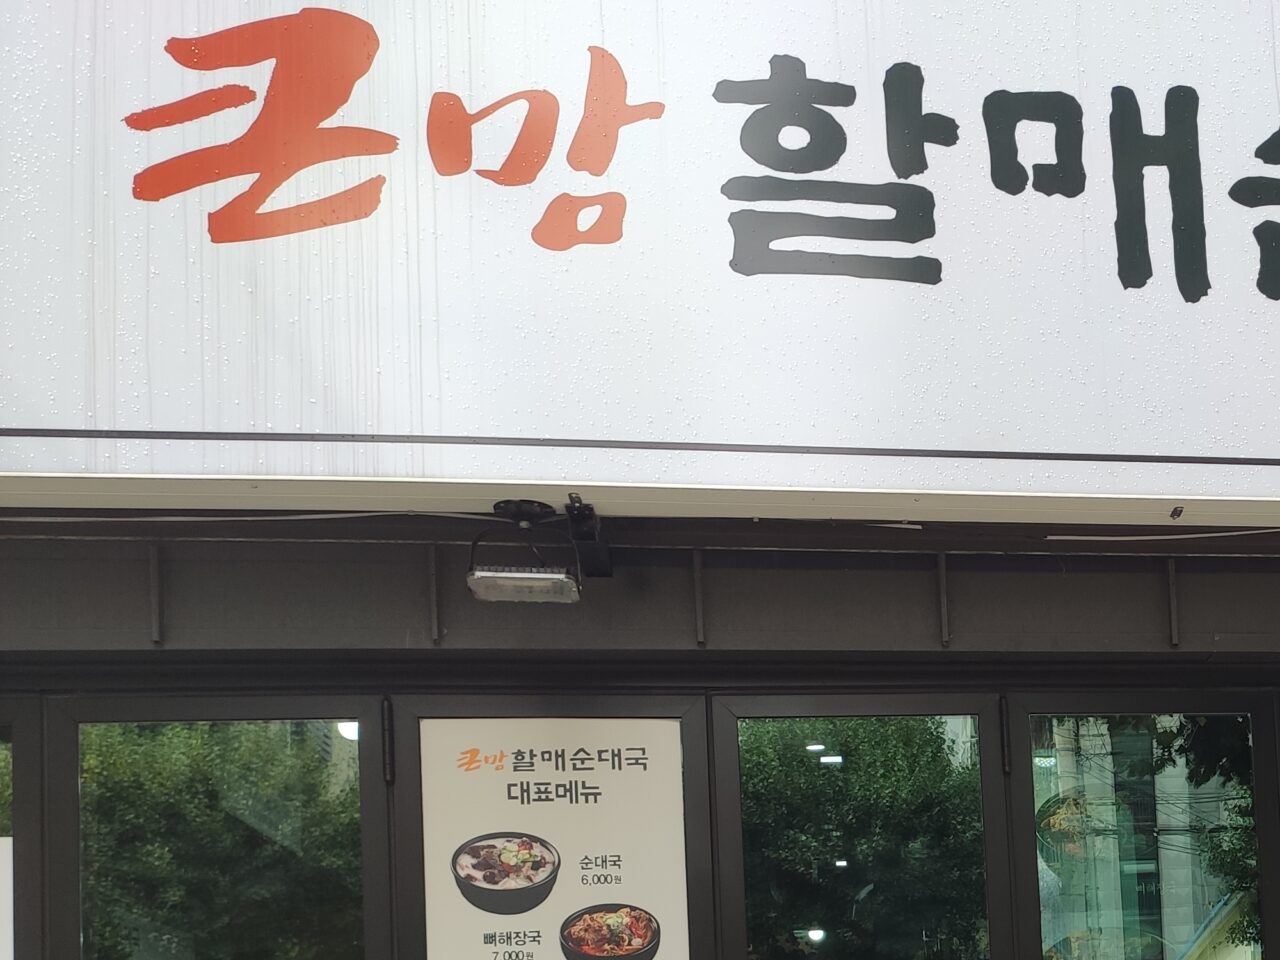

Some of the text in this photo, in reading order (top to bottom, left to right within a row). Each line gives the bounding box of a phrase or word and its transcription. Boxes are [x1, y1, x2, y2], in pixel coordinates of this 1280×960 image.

[123, 7, 665, 251] 큰맘
[511, 747, 649, 772] 할매순대국
[507, 780, 602, 805] 대표메뉴
[579, 855, 623, 870] 순대국
[581, 873, 622, 886] 6,000원
[483, 931, 542, 946] 뼈해장국
